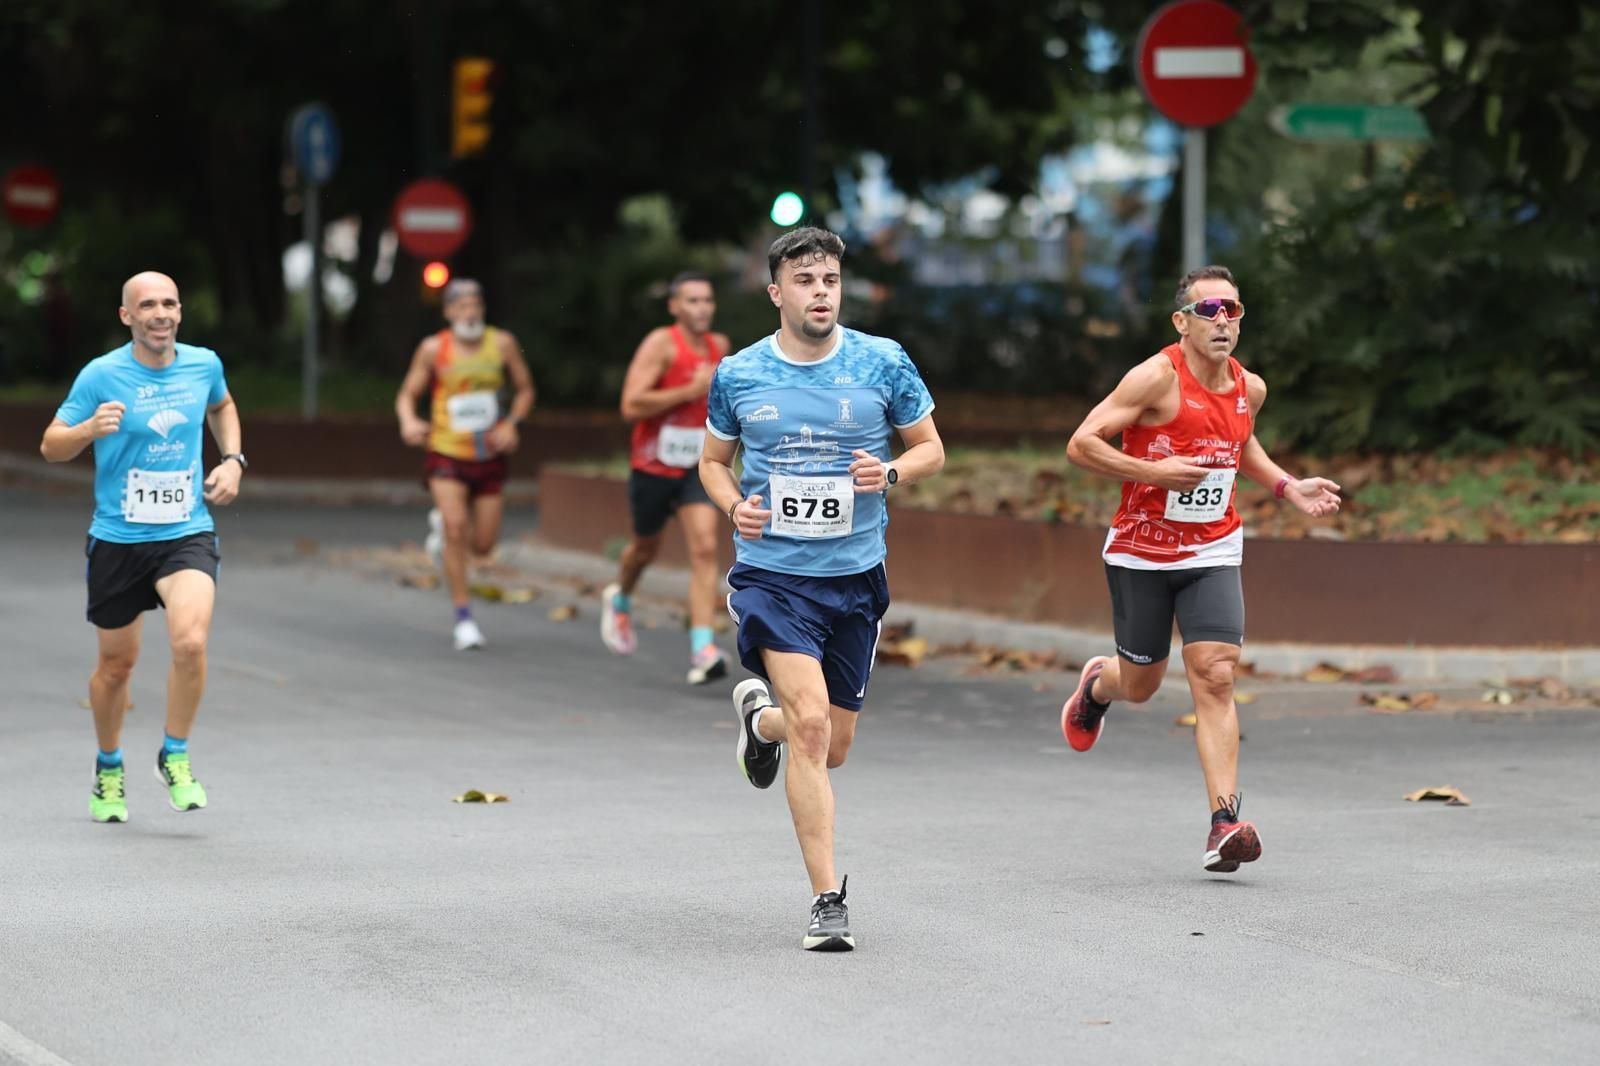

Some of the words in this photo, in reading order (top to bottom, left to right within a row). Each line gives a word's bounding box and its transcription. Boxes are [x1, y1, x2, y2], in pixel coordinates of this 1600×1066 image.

[135, 488, 184, 504] 1150
[1178, 488, 1223, 506] 833
[782, 497, 840, 519] 678
